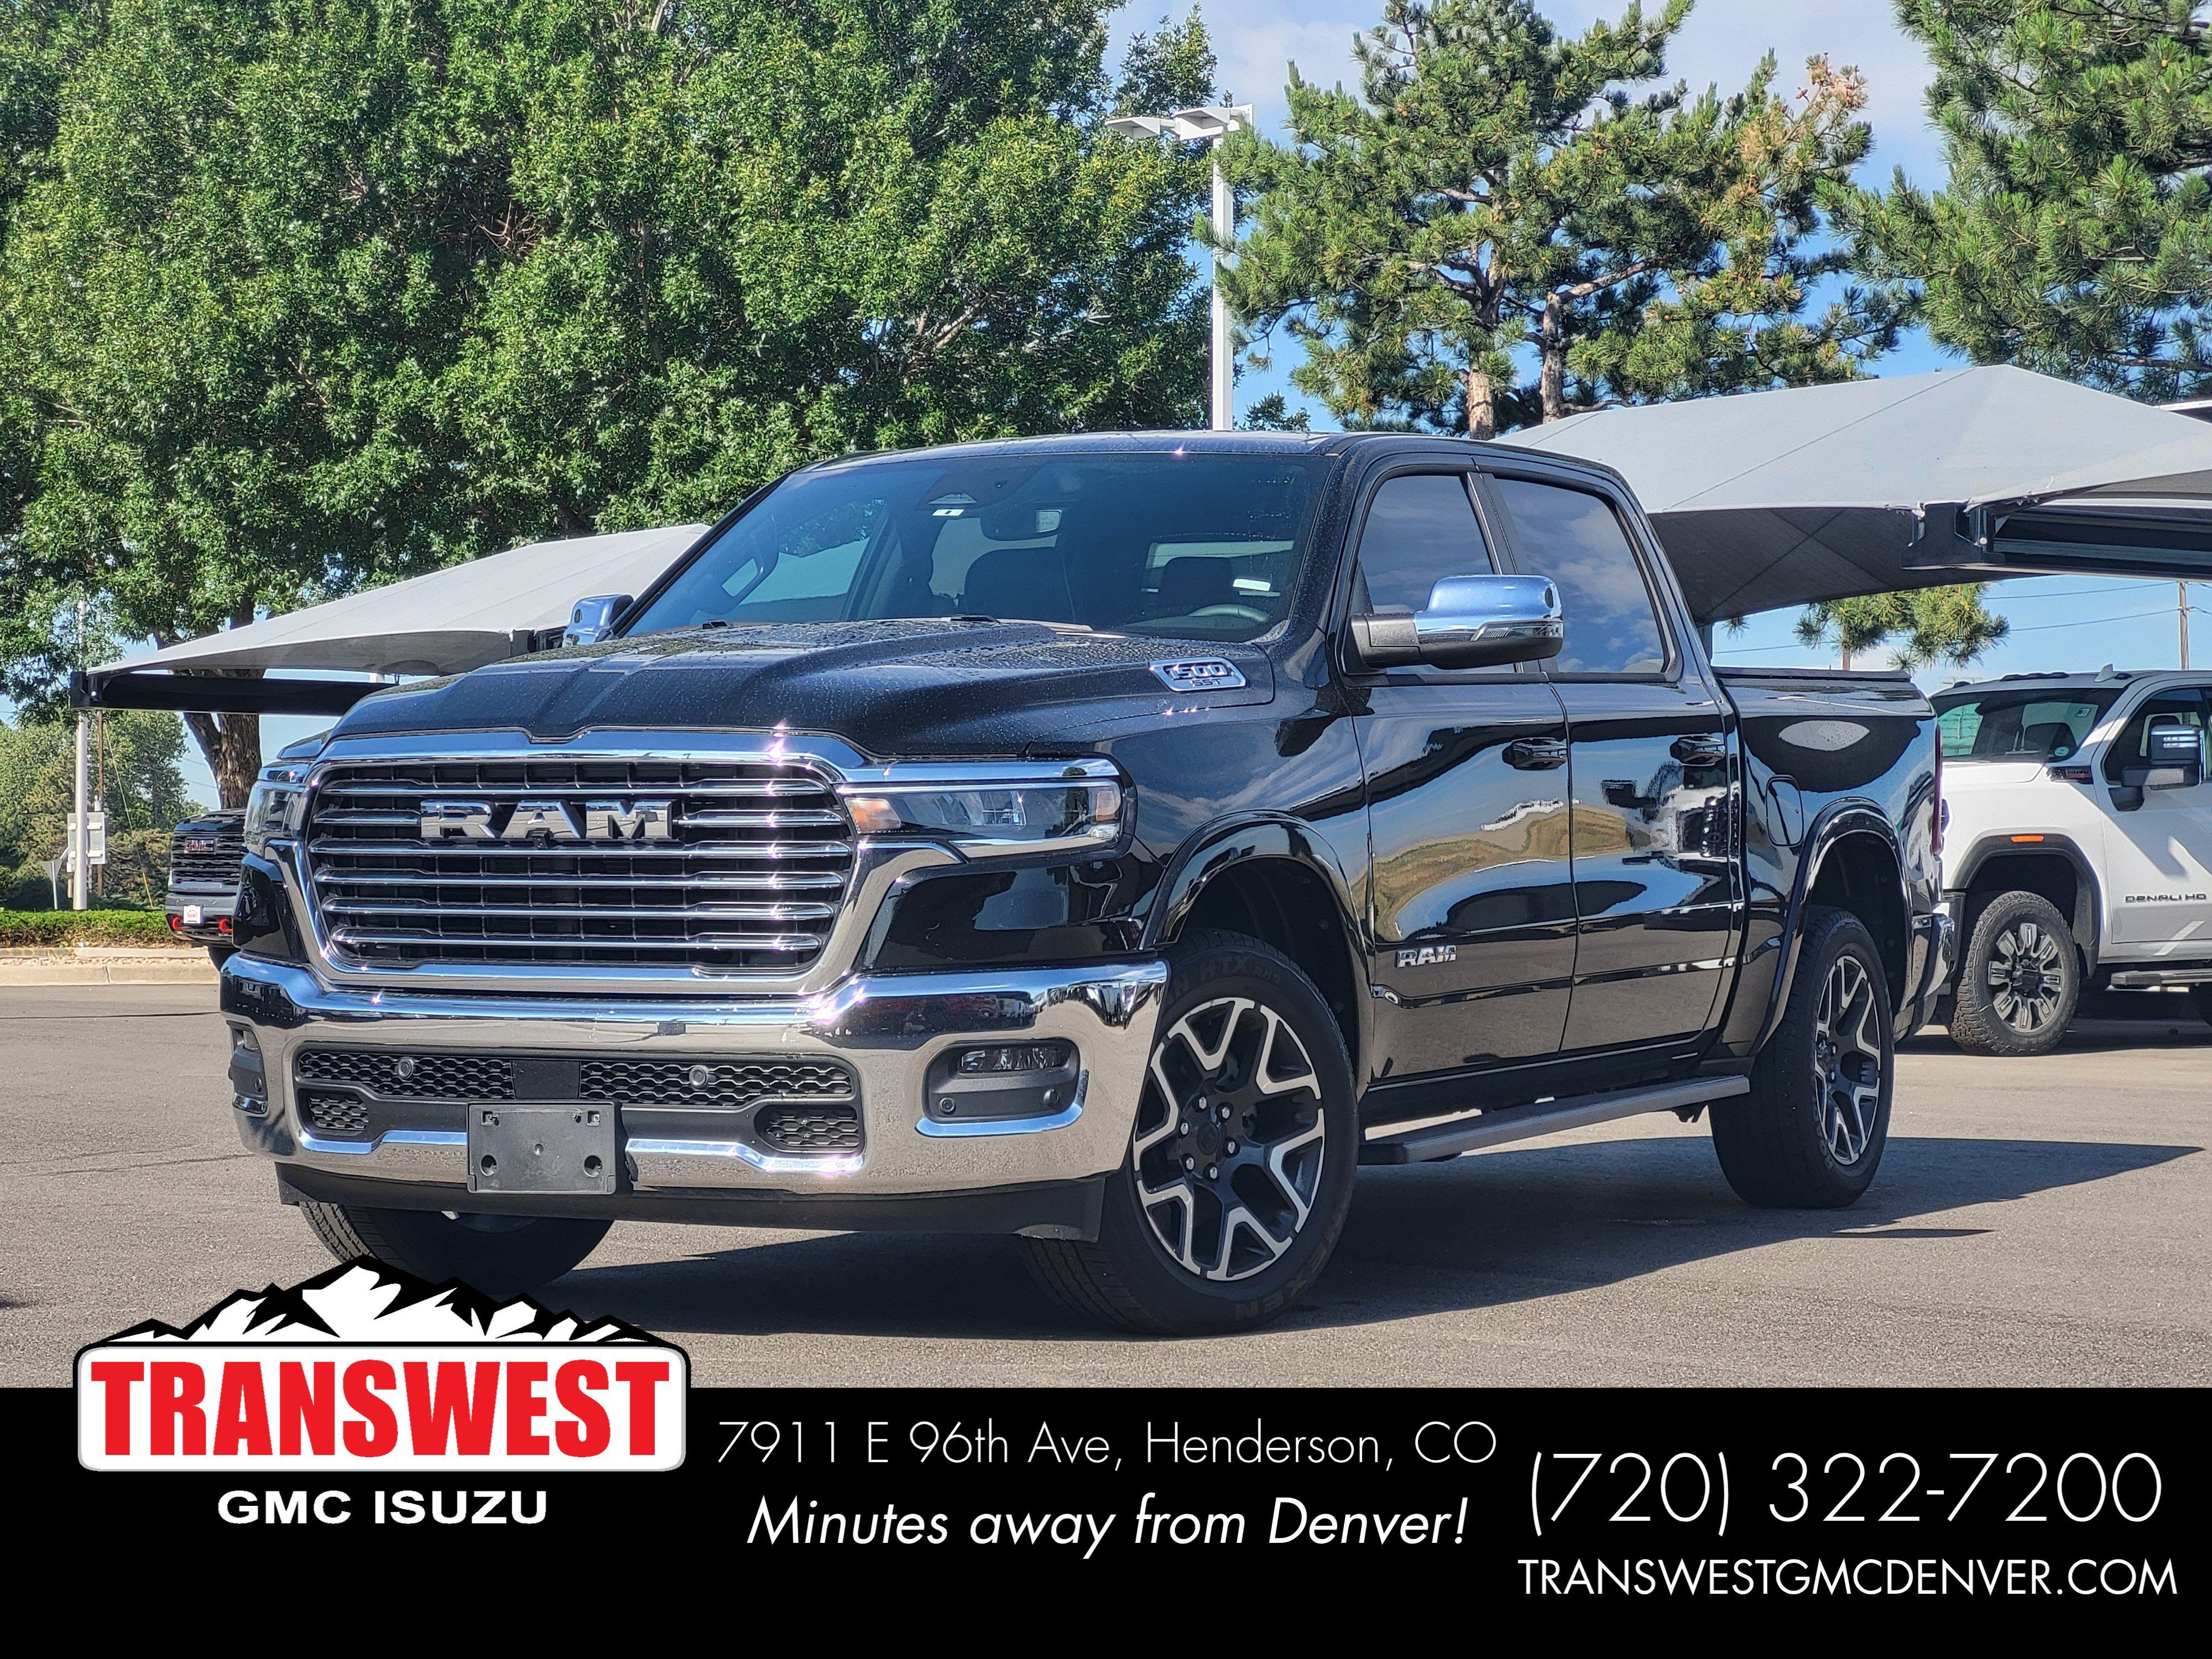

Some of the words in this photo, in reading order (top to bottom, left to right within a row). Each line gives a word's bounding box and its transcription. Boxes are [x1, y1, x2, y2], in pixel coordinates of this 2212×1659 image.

[1166, 664, 1228, 681] 1500
[420, 800, 676, 839] RAM
[2125, 894, 2182, 903] DENALI
[1395, 945, 1457, 968] RAM
